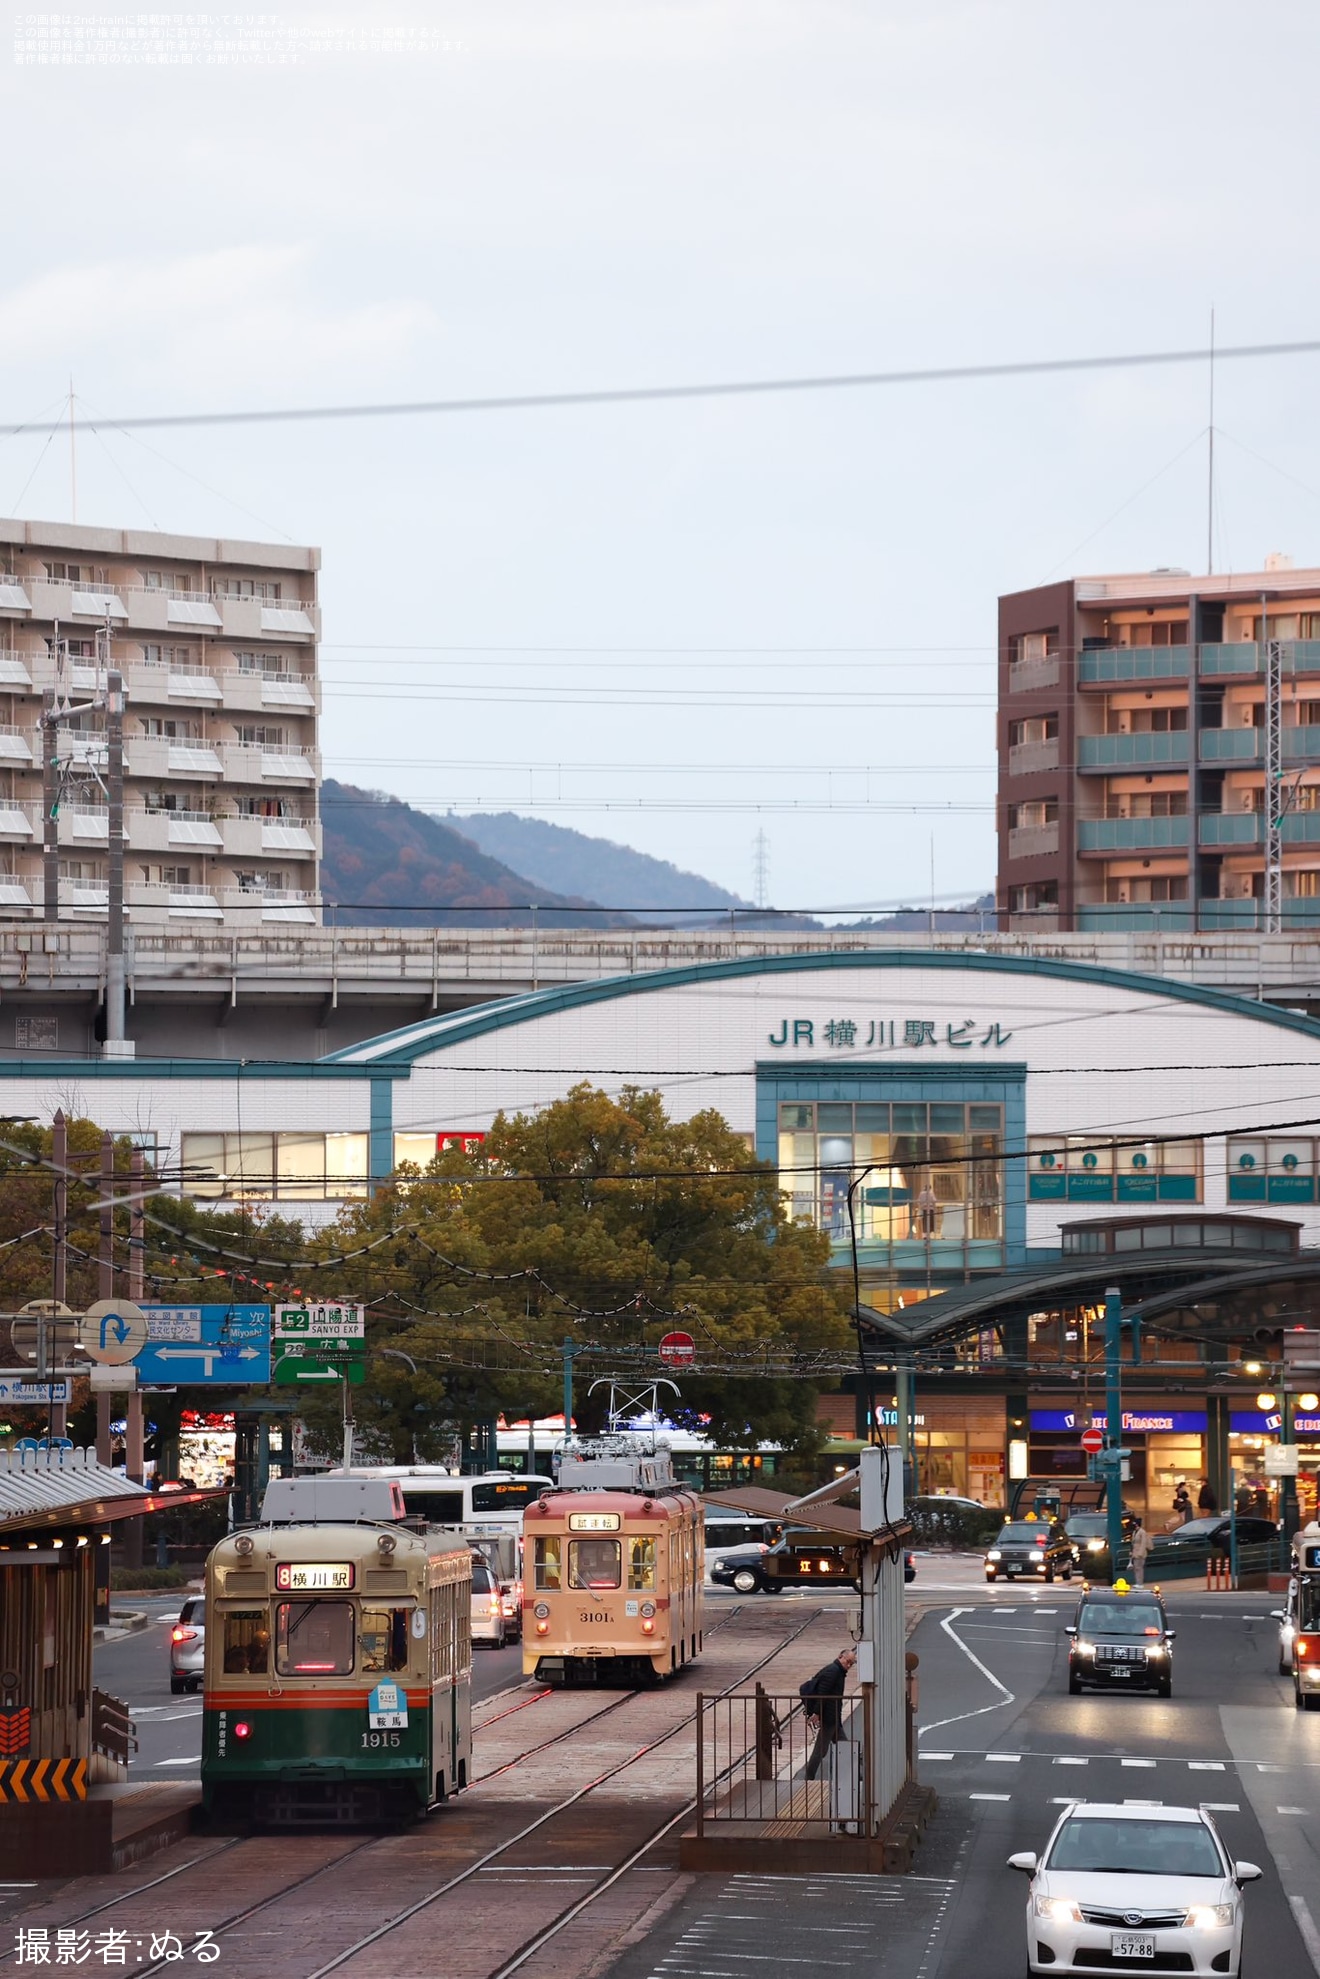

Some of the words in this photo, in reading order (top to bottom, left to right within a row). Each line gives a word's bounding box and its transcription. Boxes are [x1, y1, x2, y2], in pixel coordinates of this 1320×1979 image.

[228, 1312, 265, 1326] 三次
[286, 1315, 305, 1328] E2
[313, 1309, 359, 1323] 山陽道
[229, 1328, 262, 1339] Miyoshi
[1122, 1413, 1173, 1429] FRANCE
[279, 1568, 290, 1585] 8
[293, 1573, 347, 1586] 横川駅
[361, 1732, 400, 1748] 1915
[1121, 1944, 1152, 1956] 57-88
